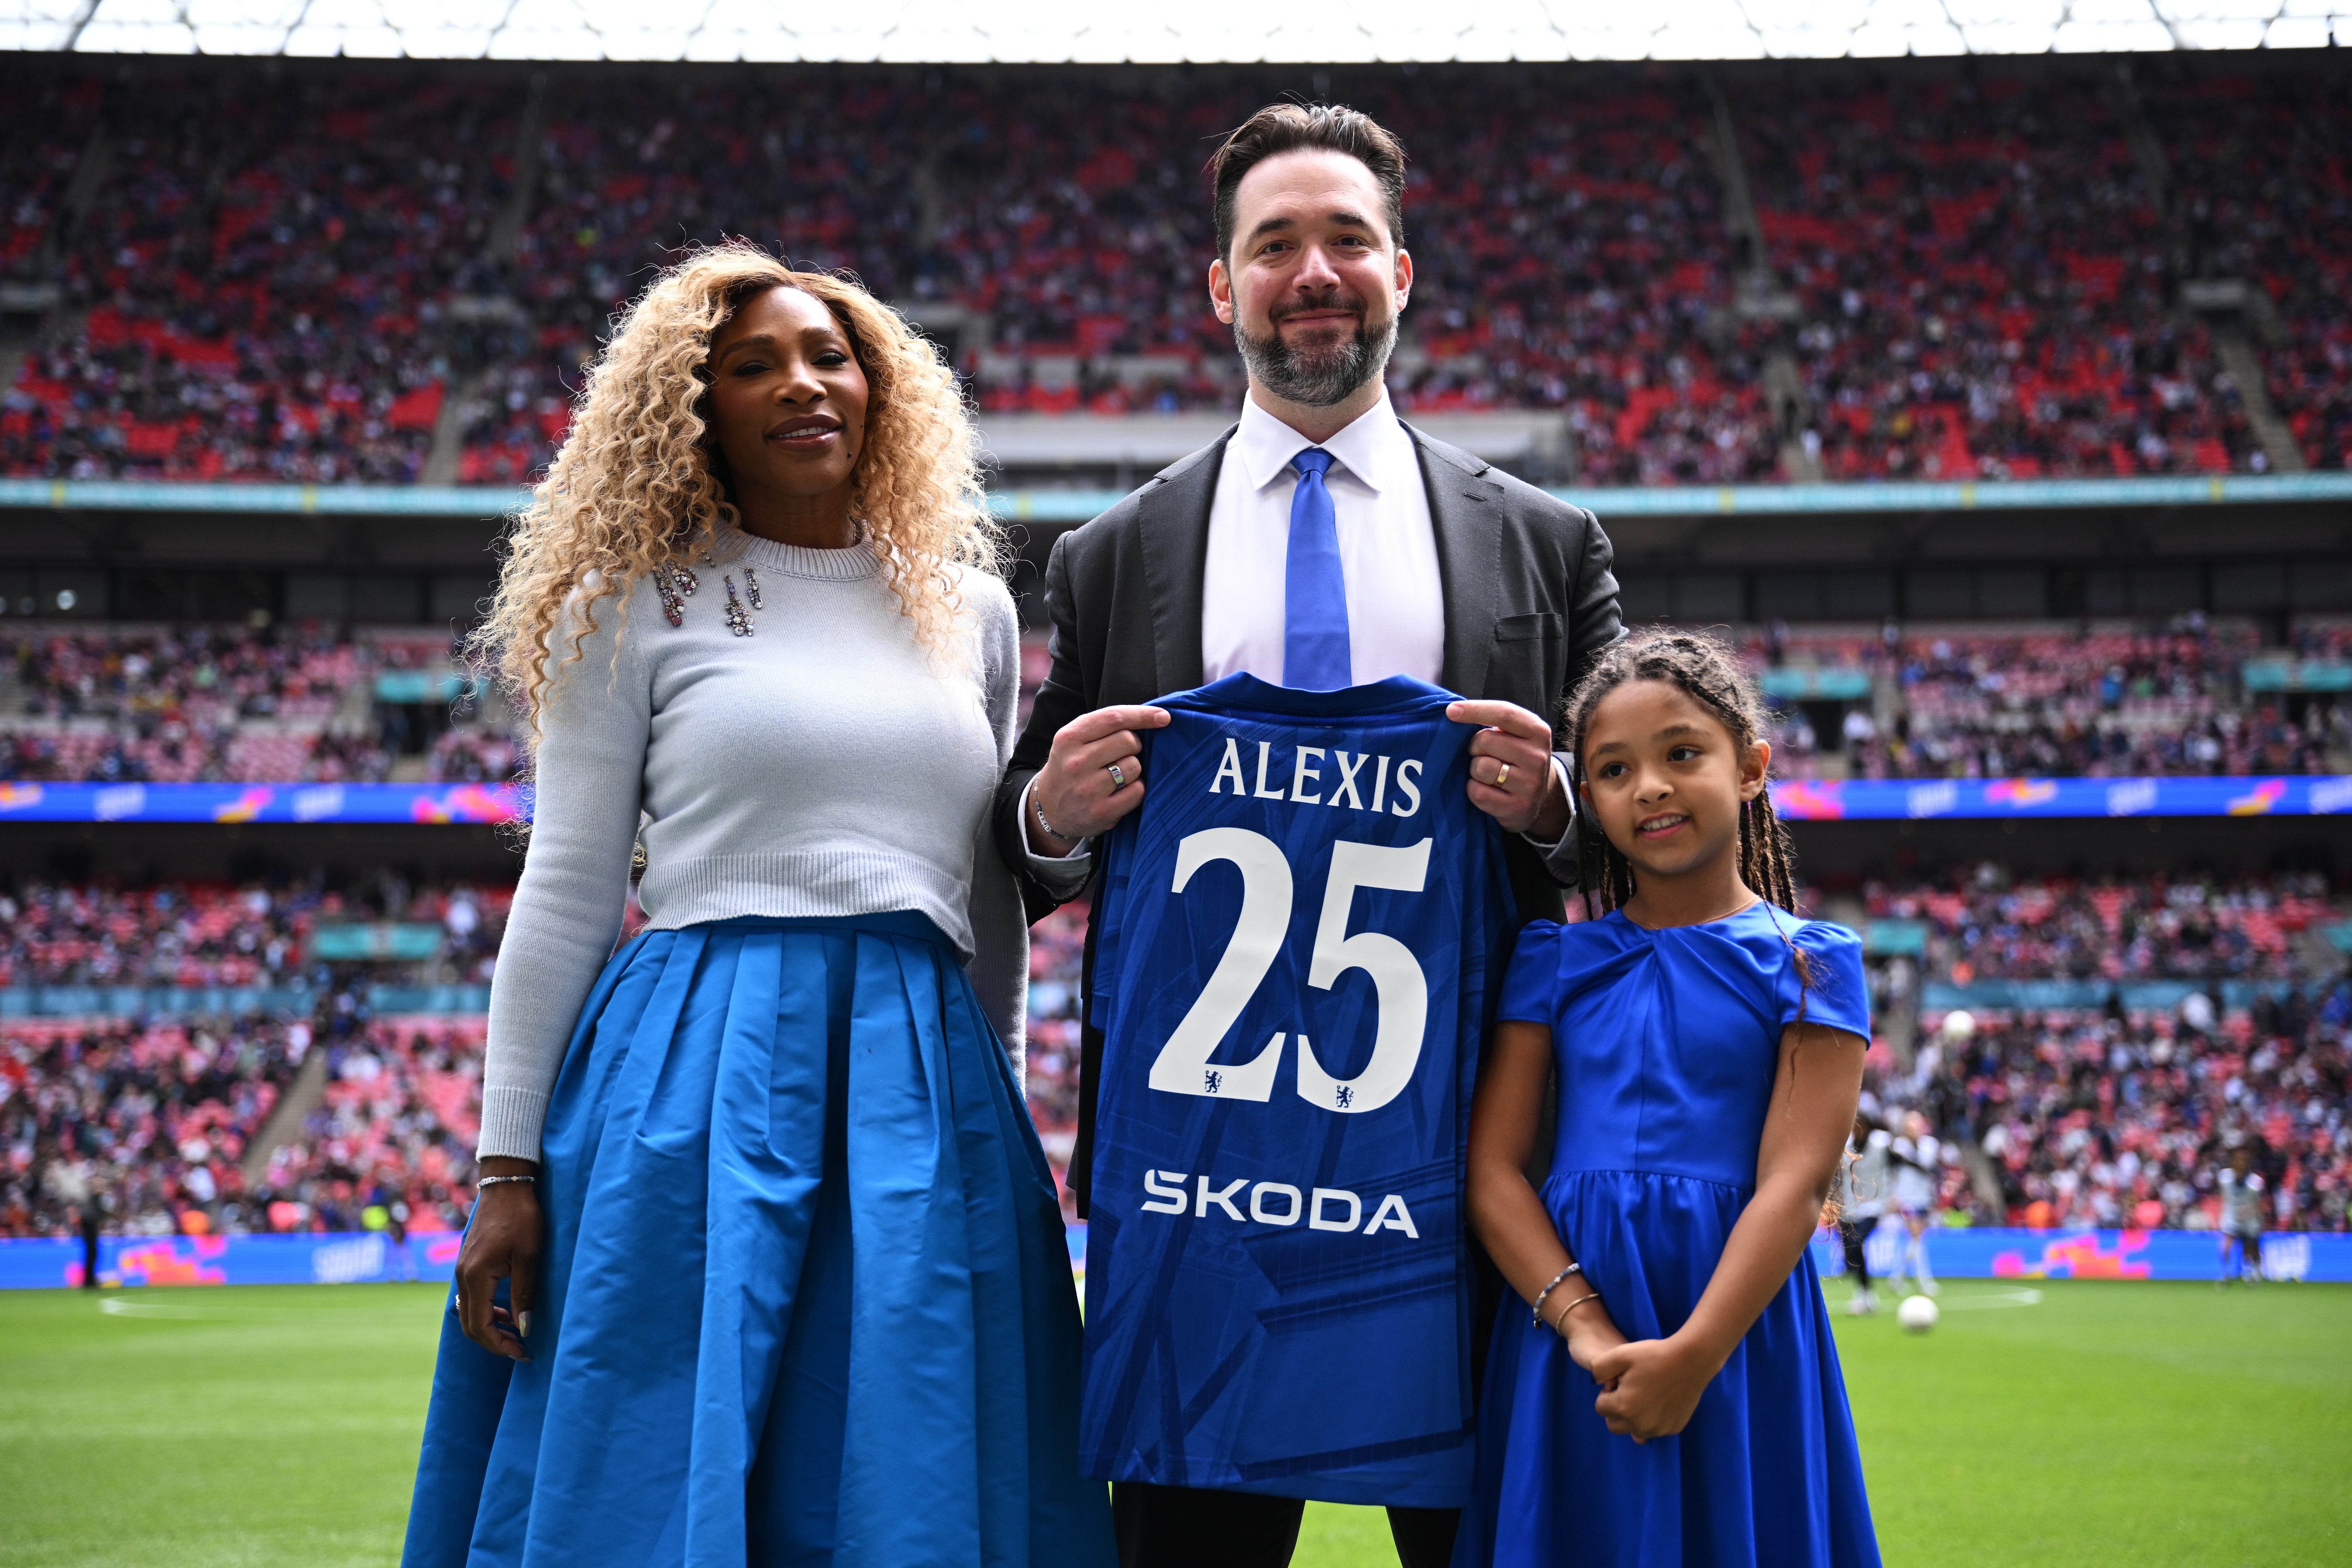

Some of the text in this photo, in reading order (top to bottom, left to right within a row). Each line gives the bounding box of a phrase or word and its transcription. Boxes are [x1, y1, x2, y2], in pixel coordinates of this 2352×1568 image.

[1209, 738, 1423, 817] ALEXIS
[1039, 812, 1050, 830] CFCW
[1148, 827, 1433, 1113] 25
